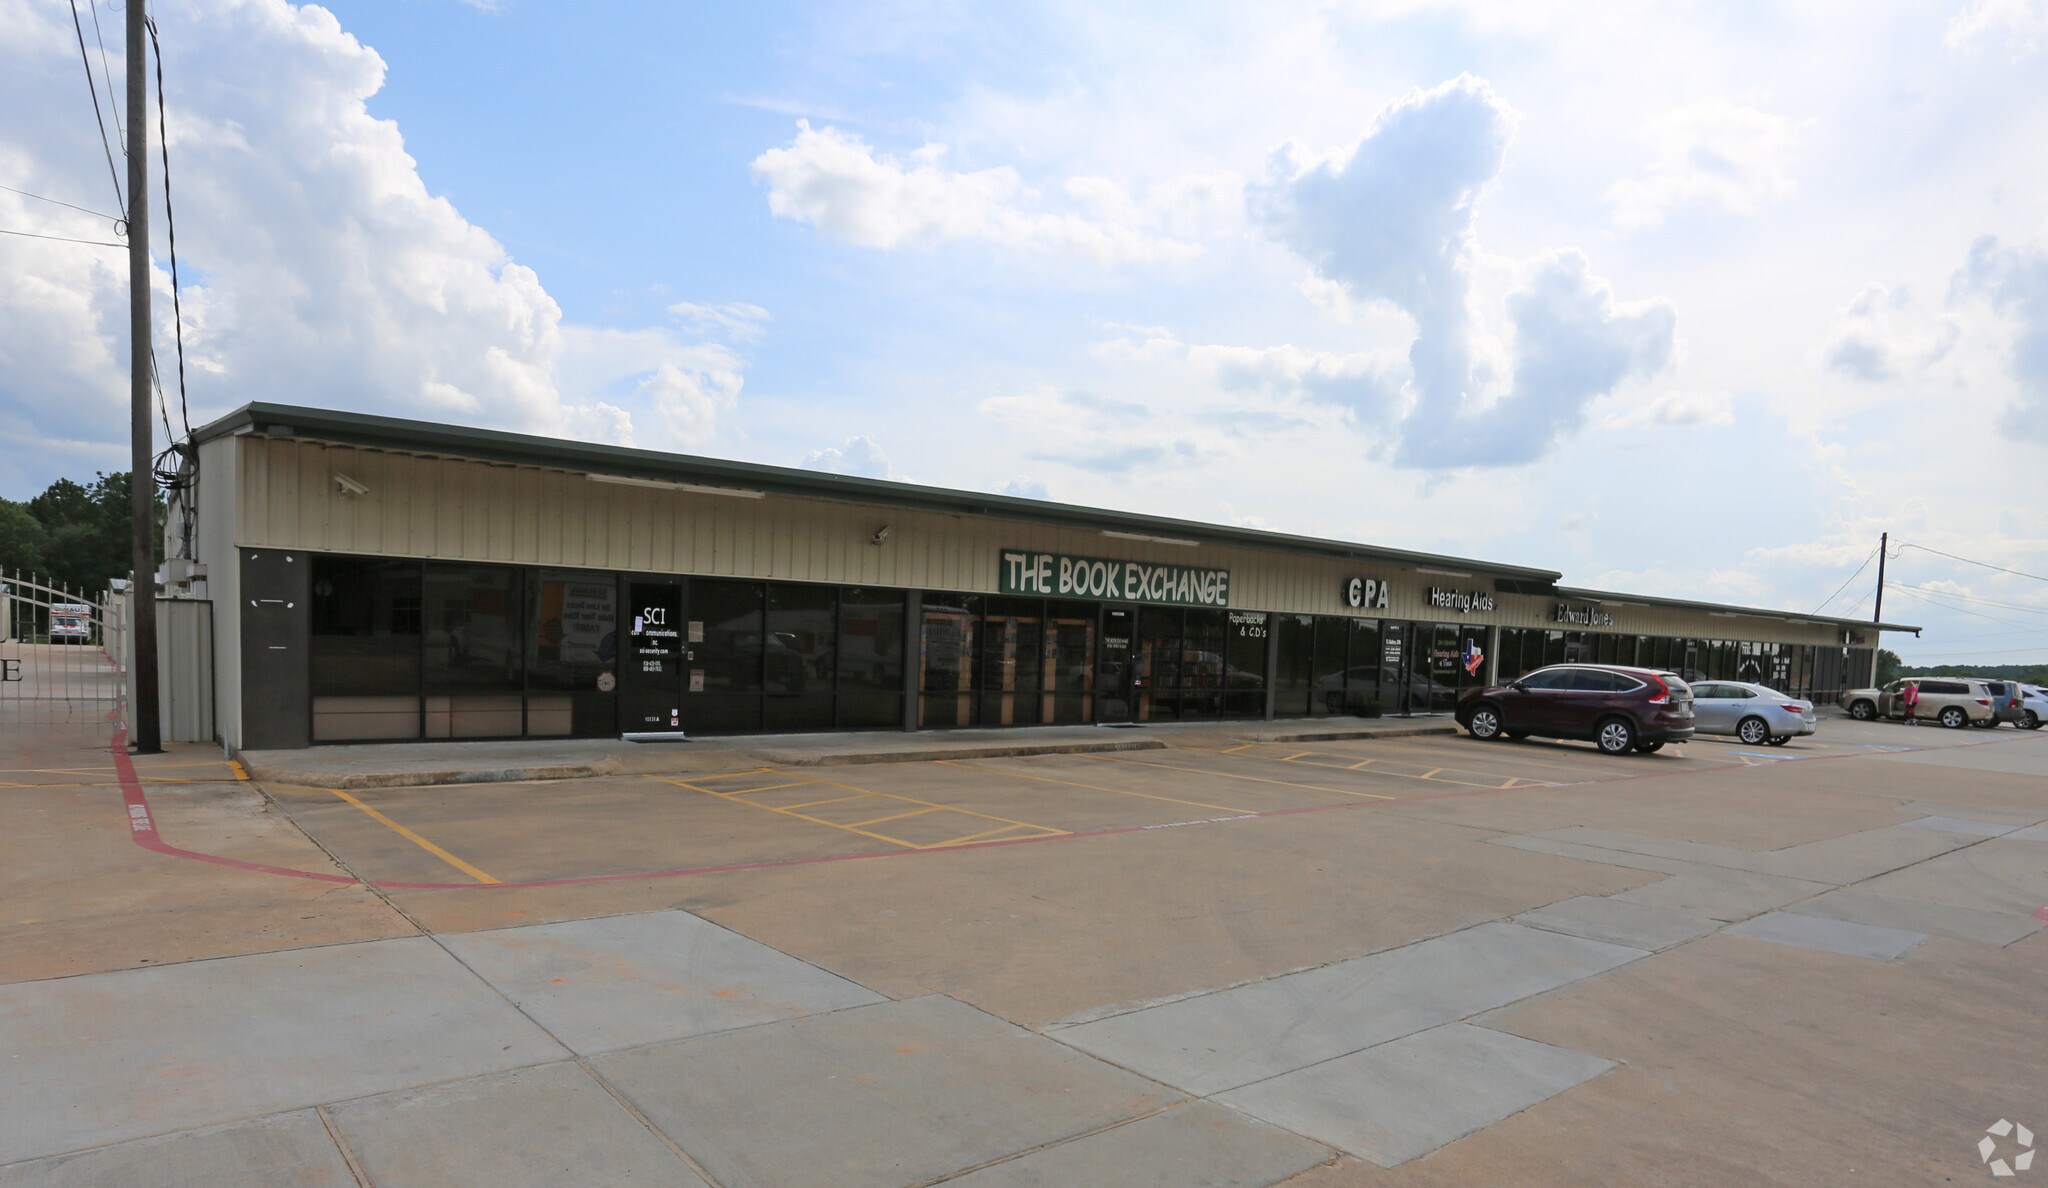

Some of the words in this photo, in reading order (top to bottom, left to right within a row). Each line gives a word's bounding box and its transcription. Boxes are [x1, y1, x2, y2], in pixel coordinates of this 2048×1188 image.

[1005, 553, 1053, 594] THE
[1059, 557, 1120, 599] BOOK
[1124, 563, 1228, 606] EXCHANGE
[1349, 578, 1389, 609] CPA
[1431, 586, 1470, 614] Hearing
[1471, 591, 1494, 612] Aids
[643, 607, 666, 625] SCI
[1229, 611, 1264, 626] Paperbacks
[1557, 603, 1589, 624] Edward
[1589, 607, 1614, 627] Jones
[1240, 626, 1246, 637] &
